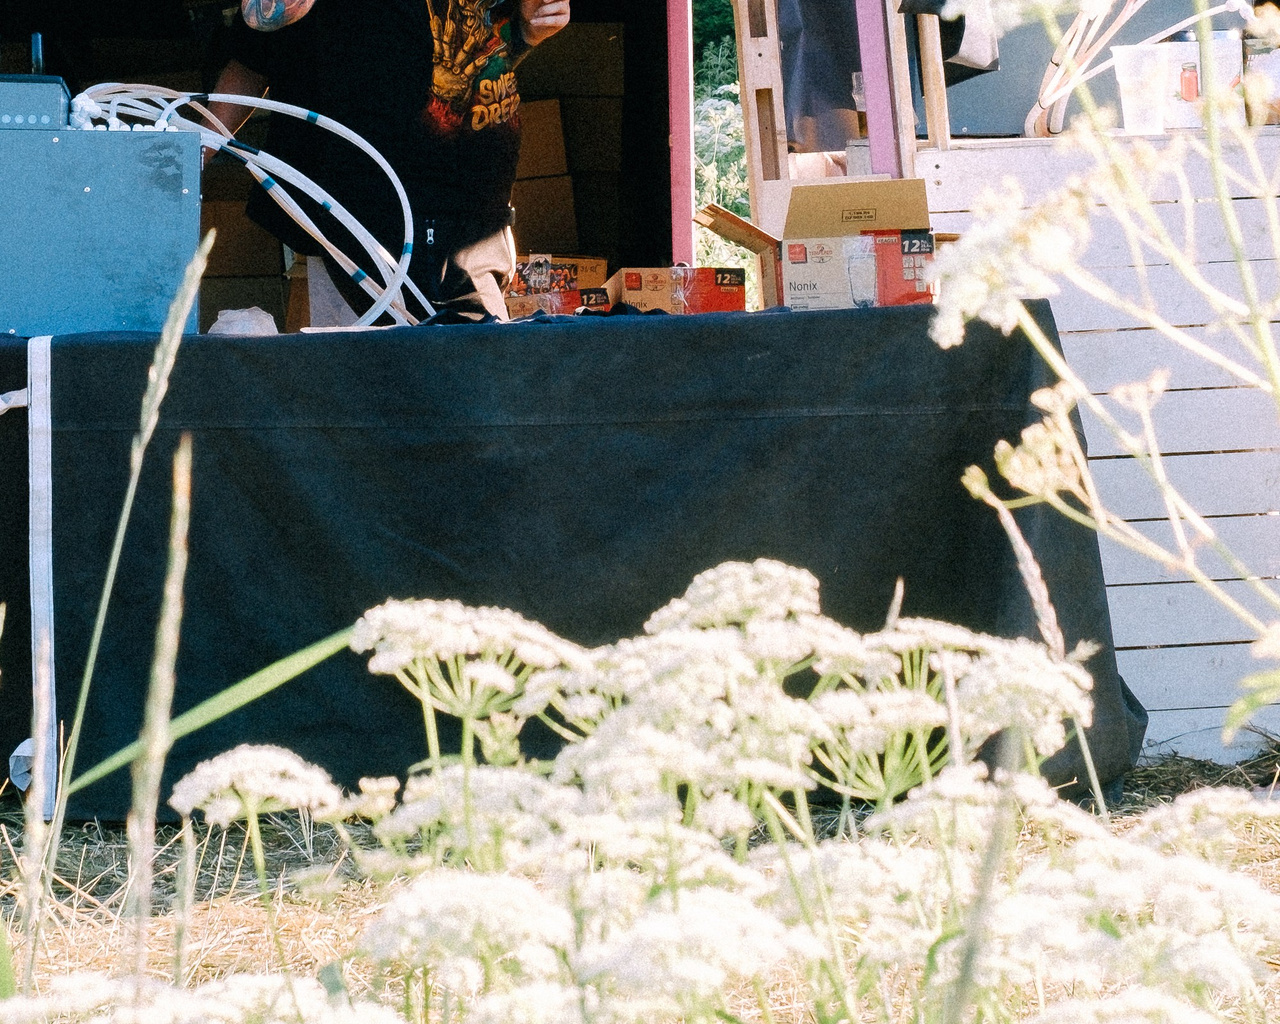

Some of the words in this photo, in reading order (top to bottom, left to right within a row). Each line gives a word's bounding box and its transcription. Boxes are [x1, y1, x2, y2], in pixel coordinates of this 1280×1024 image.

[902, 239, 921, 253] 12
[716, 273, 731, 284] 12
[789, 281, 818, 292] Nonix
[582, 294, 596, 305] 12
